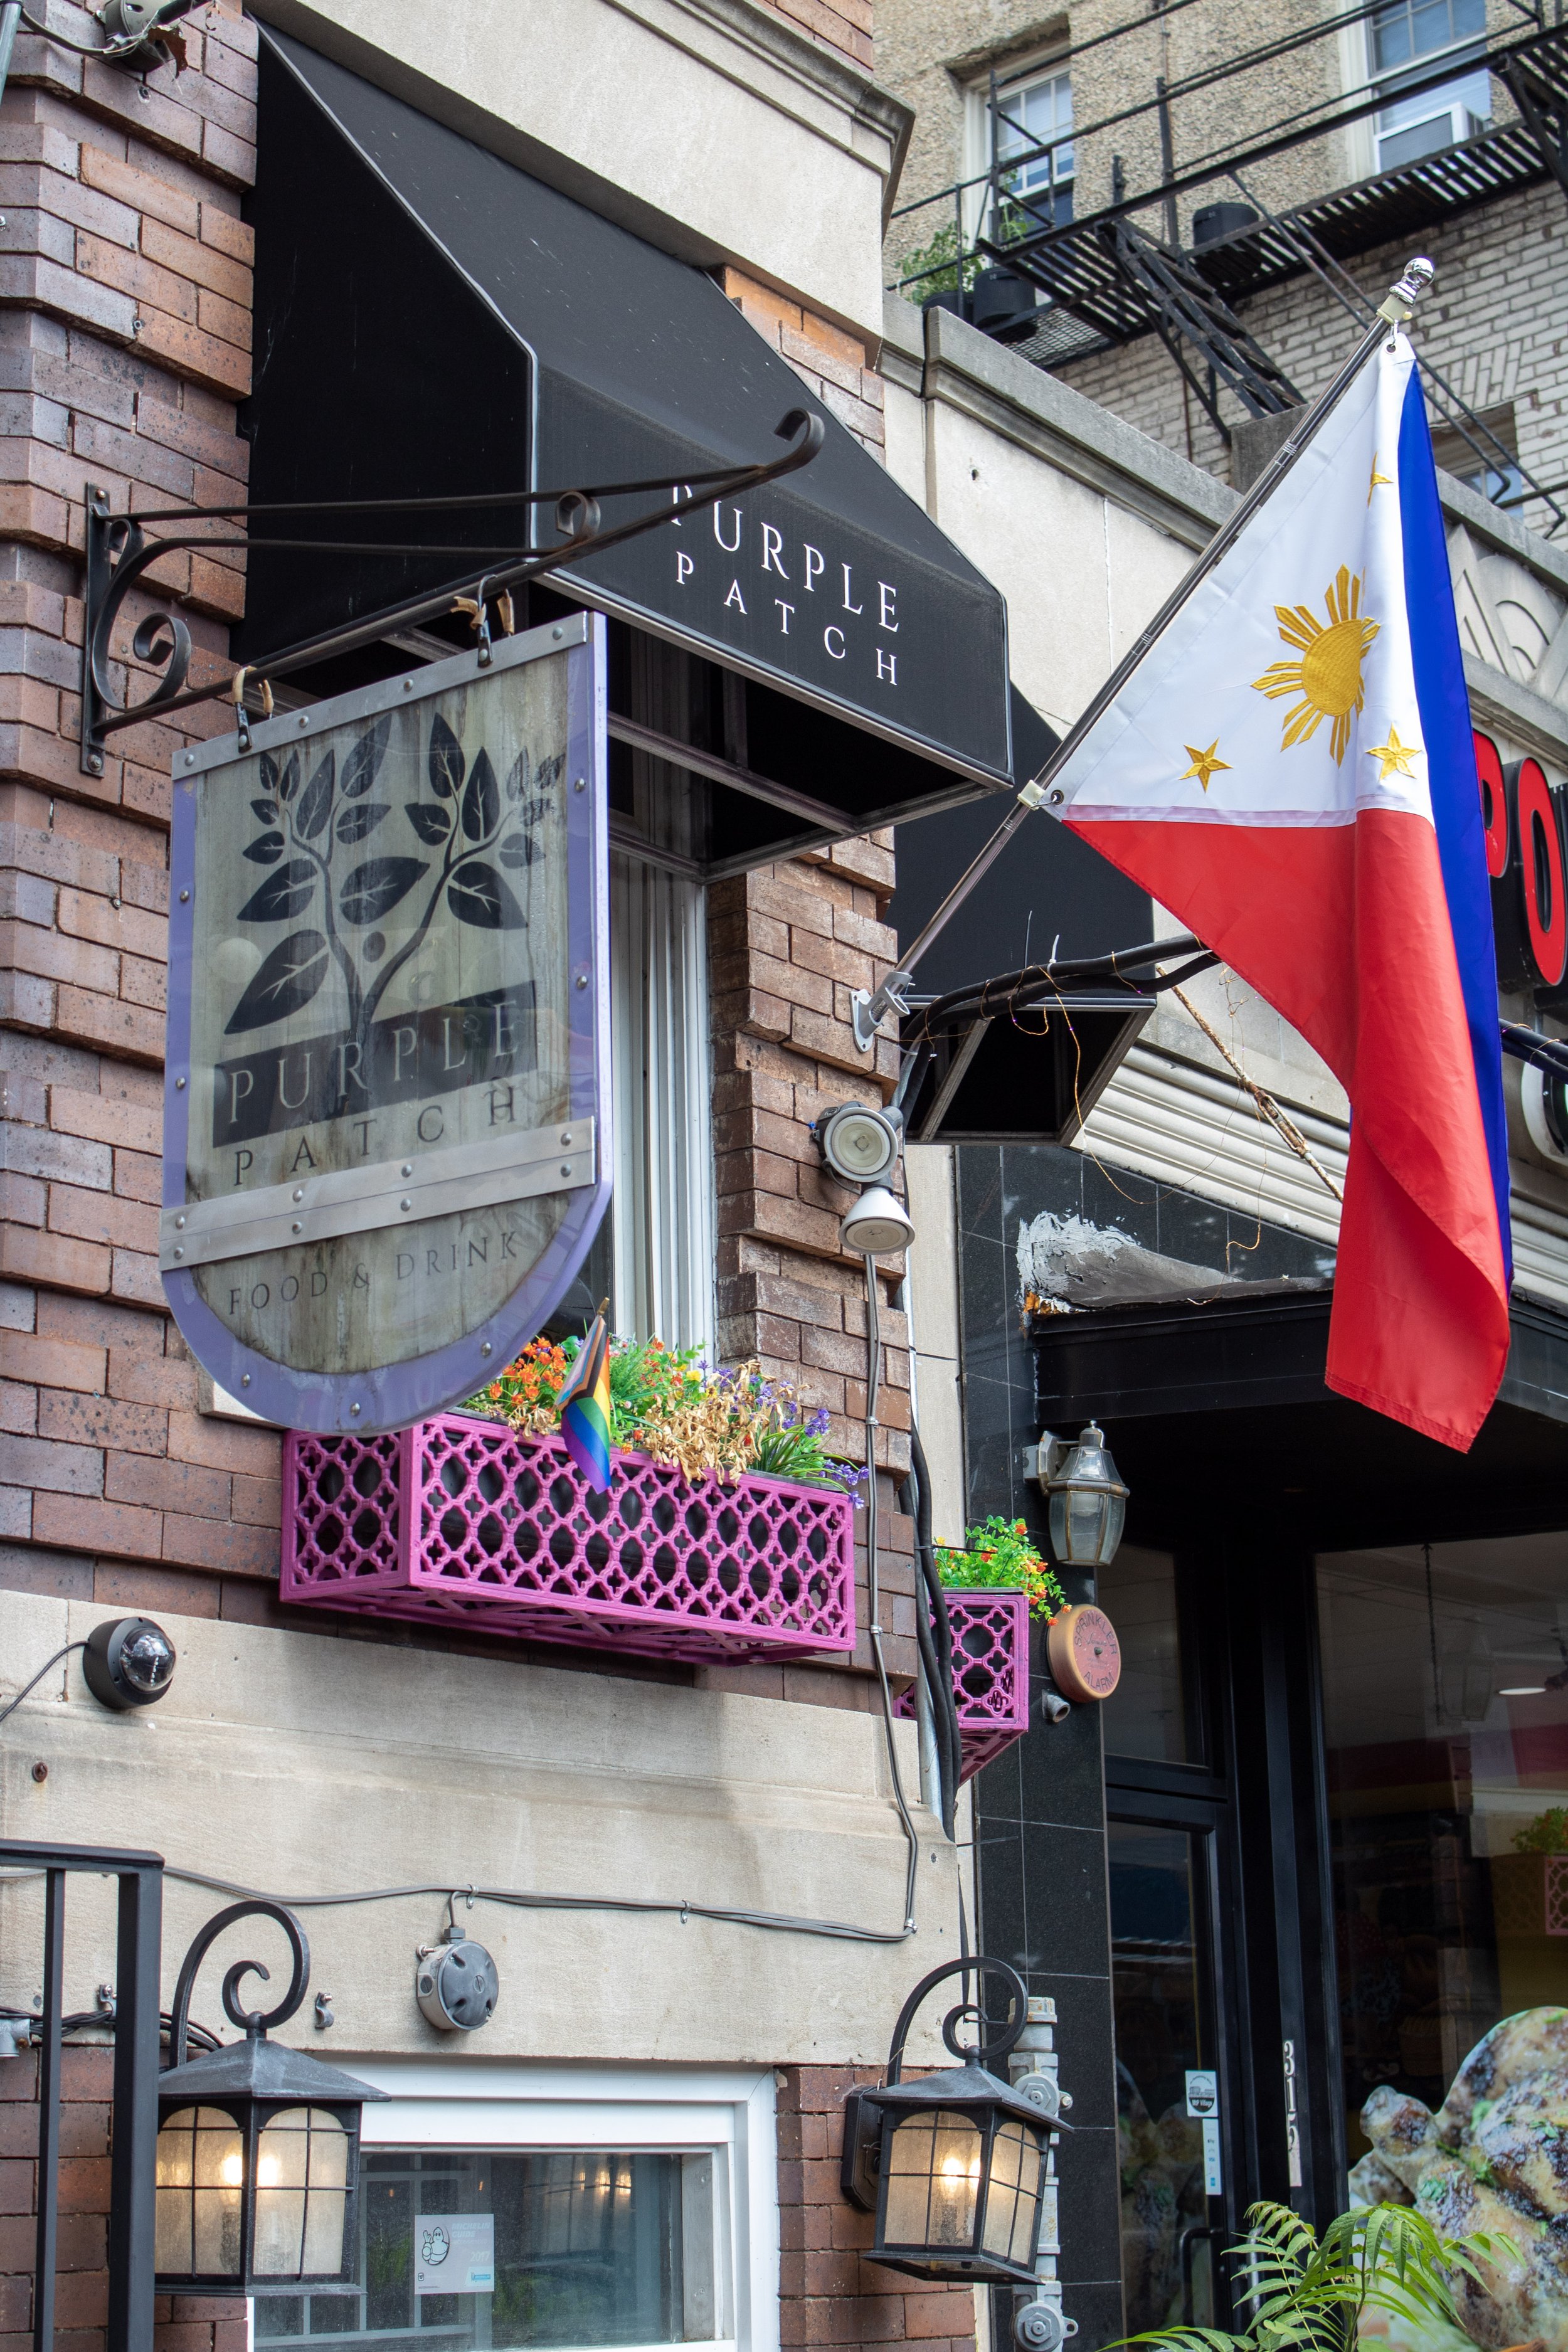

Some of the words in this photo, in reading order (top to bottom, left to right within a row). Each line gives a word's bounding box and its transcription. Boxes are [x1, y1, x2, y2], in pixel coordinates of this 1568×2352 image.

[676, 551, 898, 686] PATCH
[229, 1001, 519, 1123] PURPLE
[233, 1086, 516, 1185] PATCH
[229, 1271, 328, 1315] FOOD
[352, 1263, 370, 1289] &
[396, 1231, 517, 1280] DRINK
[1074, 1613, 1117, 1655] SPRINKLER
[1084, 1671, 1115, 1692] ALARM
[452, 2230, 476, 2238] GUIDE
[470, 2251, 490, 2262] 2017
